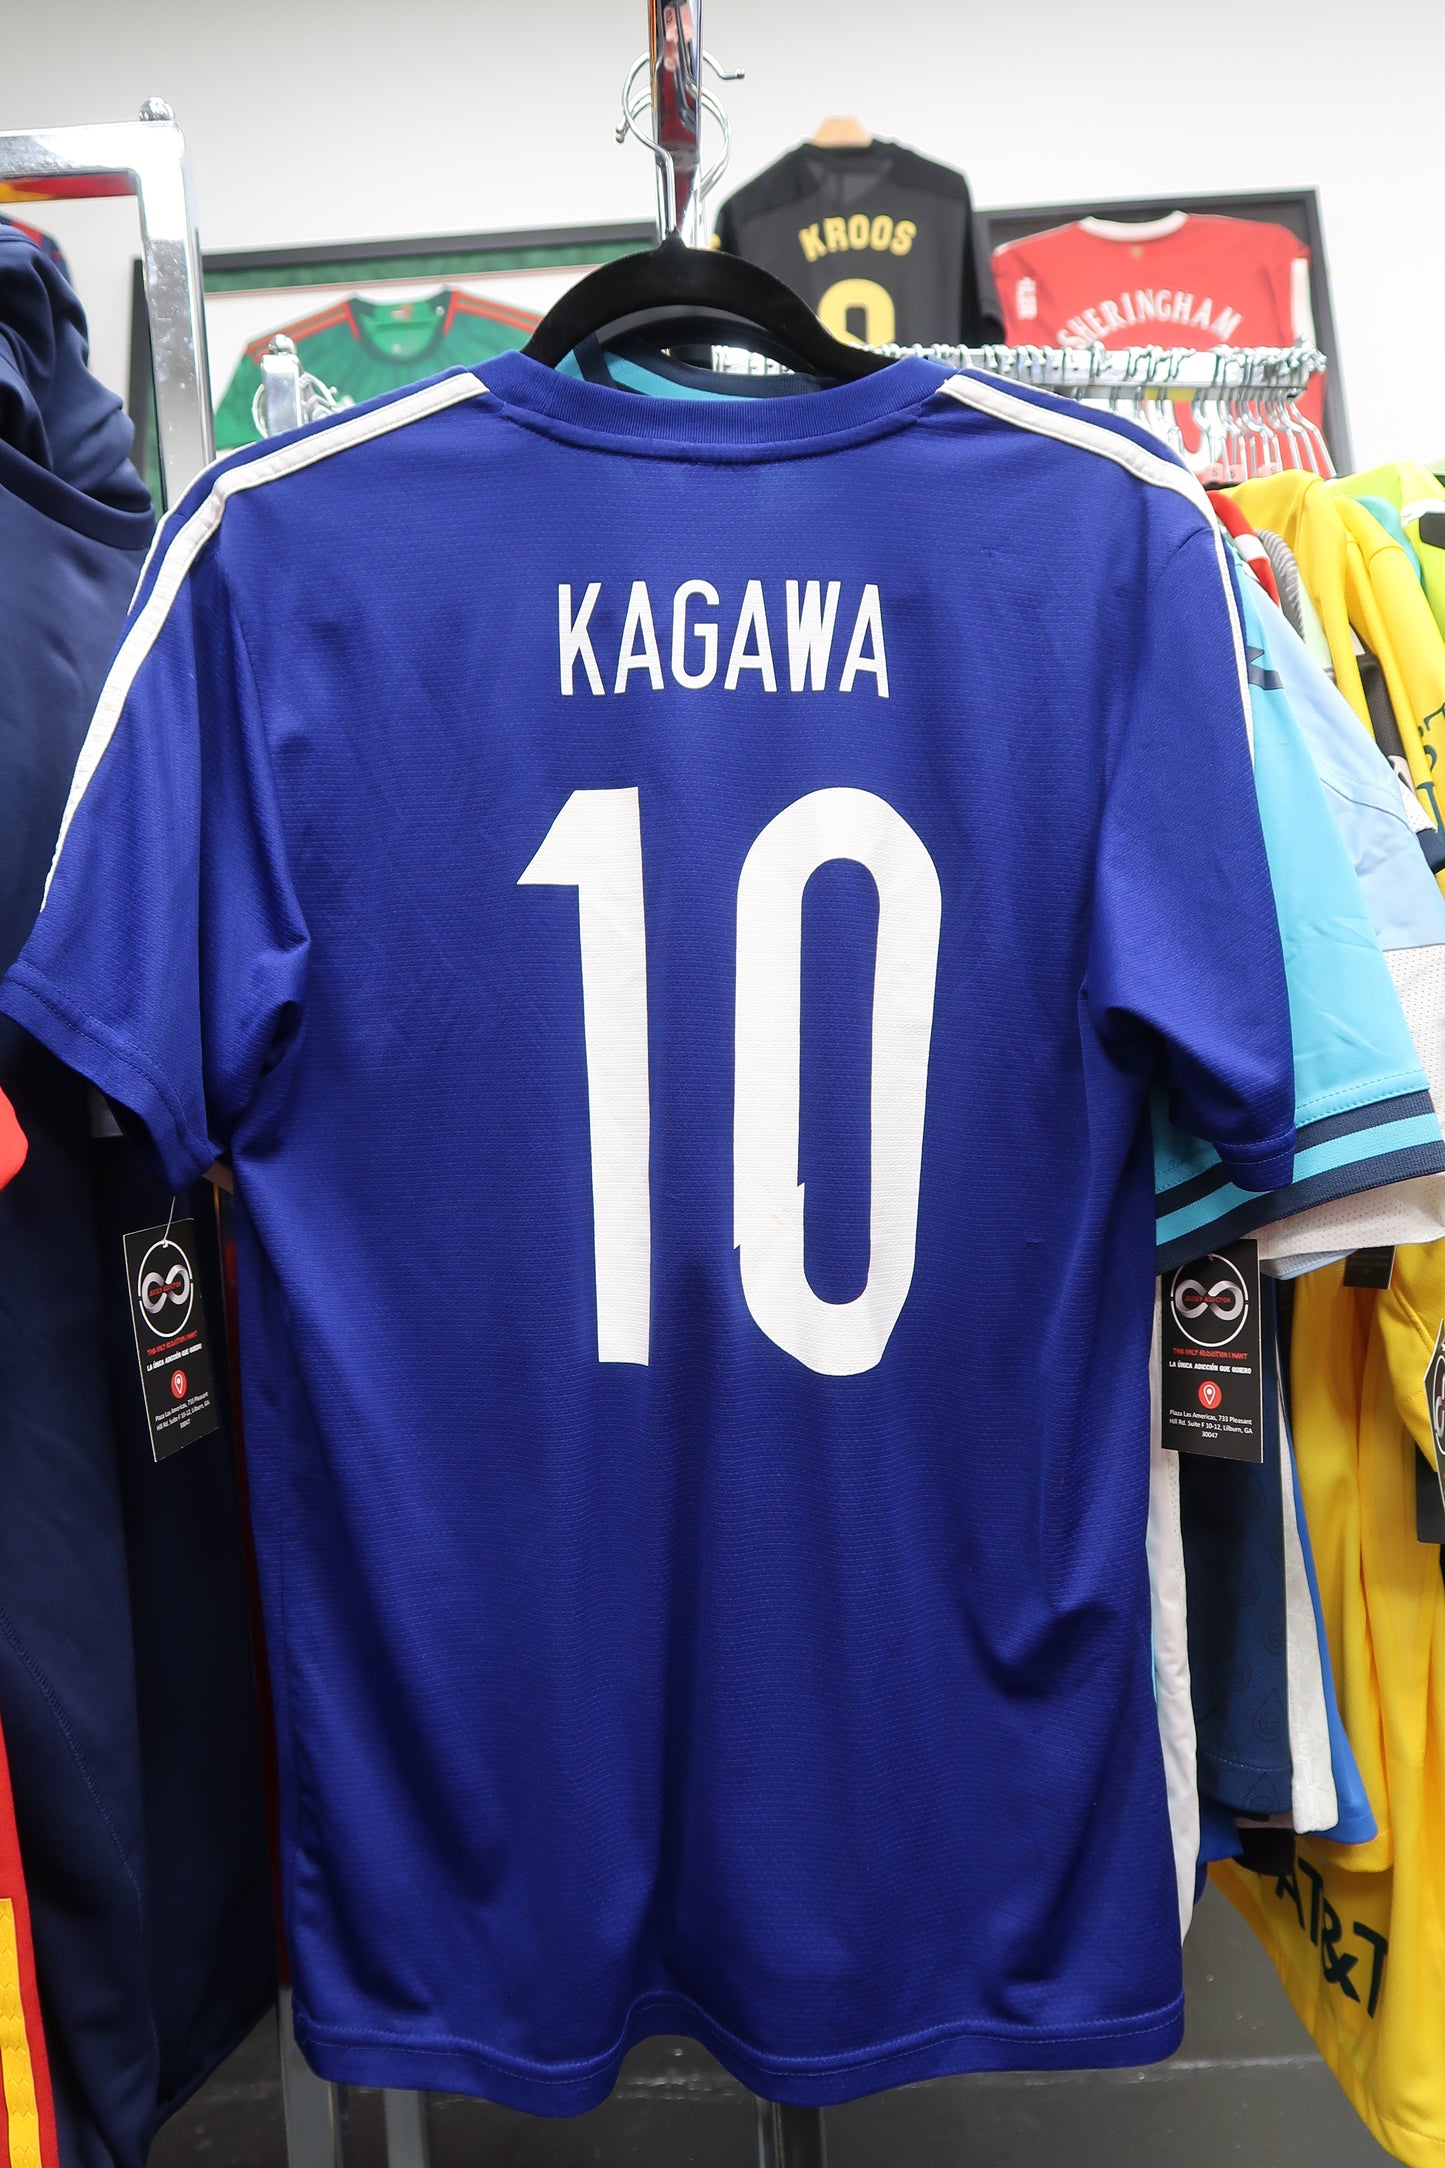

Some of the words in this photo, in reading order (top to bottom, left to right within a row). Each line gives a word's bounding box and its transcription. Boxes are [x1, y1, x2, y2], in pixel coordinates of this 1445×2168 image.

[799, 213, 917, 263] KROOS
[1057, 288, 1243, 350] SHERINGHAM
[558, 579, 890, 699] KAGAWA
[516, 786, 942, 1378] 10
[1169, 1360, 1176, 1368] LA
[1169, 1409, 1182, 1417] Plaza
[1183, 1410, 1192, 1418] Las
[1192, 1412, 1217, 1422] Americas,
[1218, 1414, 1228, 1422] 733
[1229, 1416, 1252, 1425] Pleasant
[1178, 1418, 1186, 1426] Rd.
[1187, 1420, 1200, 1428] Suite
[1222, 1425, 1243, 1434] Lilburn,
[1244, 1427, 1253, 1435] GA
[1201, 1431, 1218, 1439] 30047
